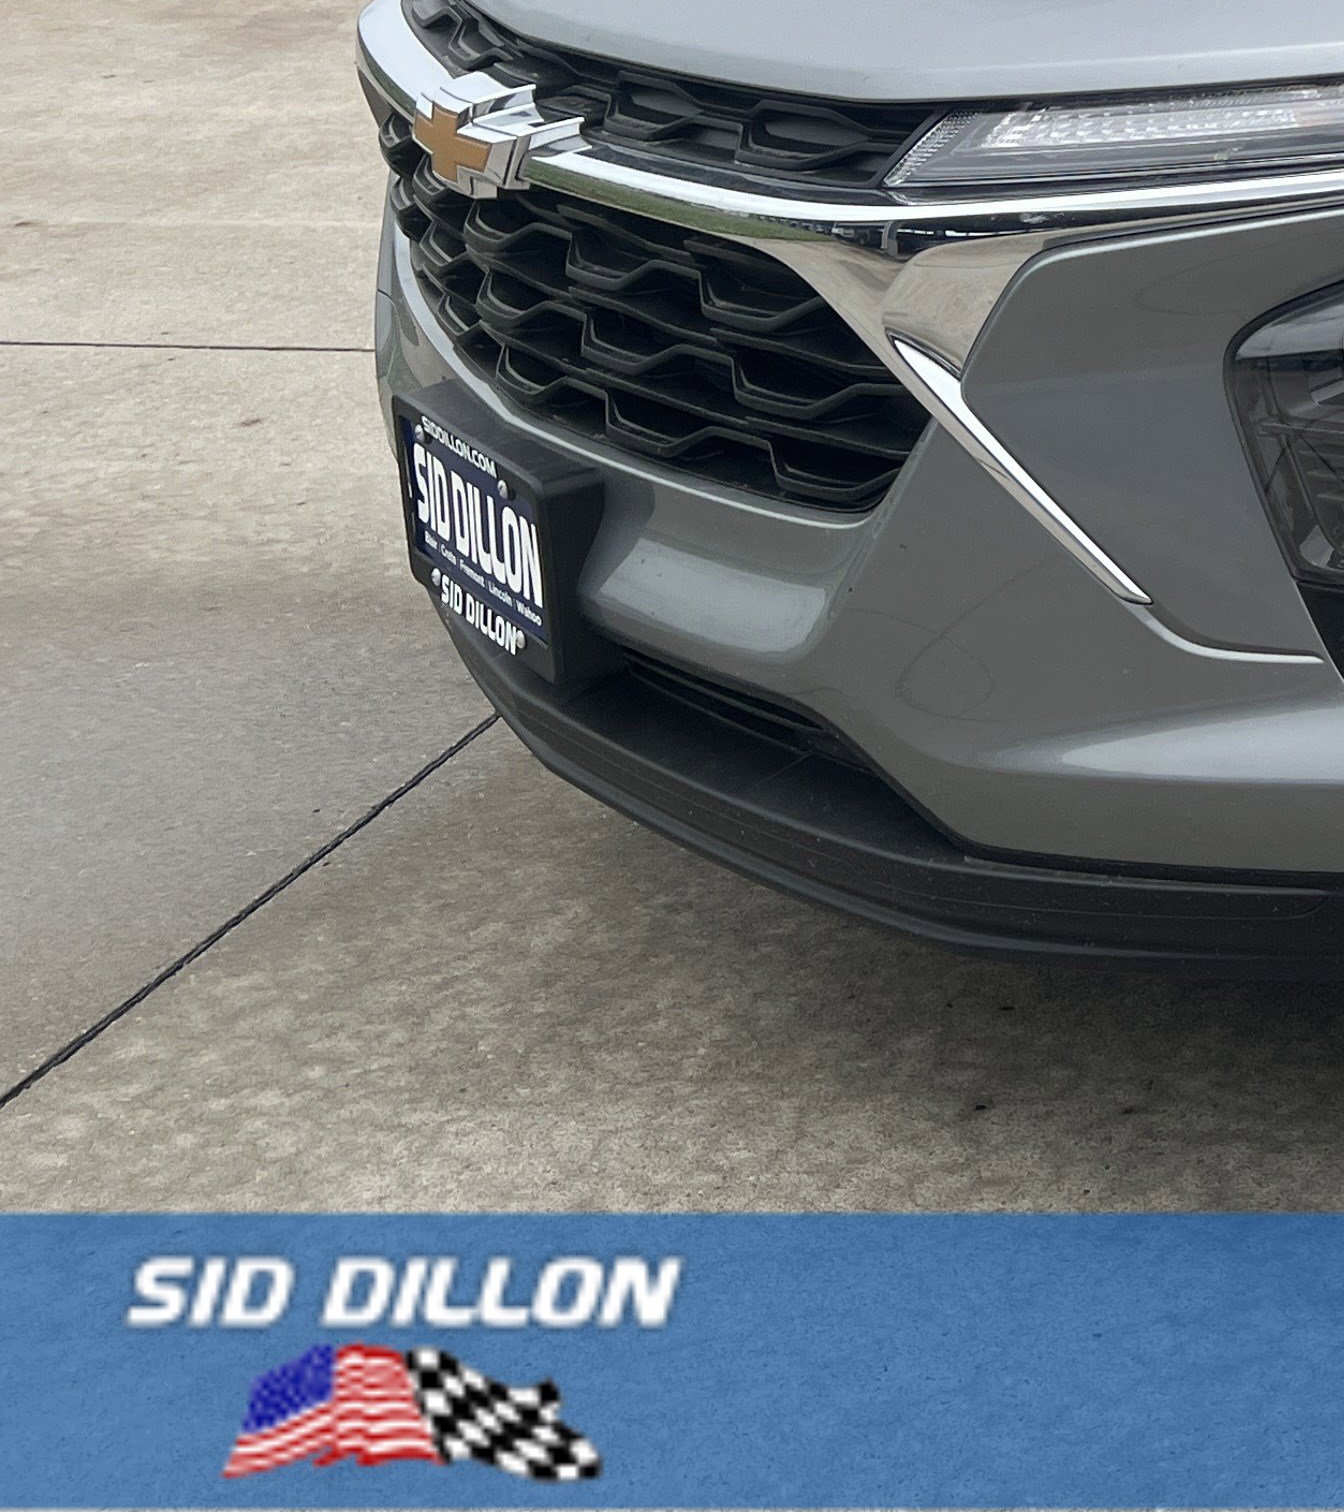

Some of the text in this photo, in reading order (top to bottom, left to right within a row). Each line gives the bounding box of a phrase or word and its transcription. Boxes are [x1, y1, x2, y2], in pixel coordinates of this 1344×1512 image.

[421, 415, 497, 479] SIDDILLON.COM
[413, 442, 543, 608] SID DILLON
[441, 574, 517, 656] SID DILLON
